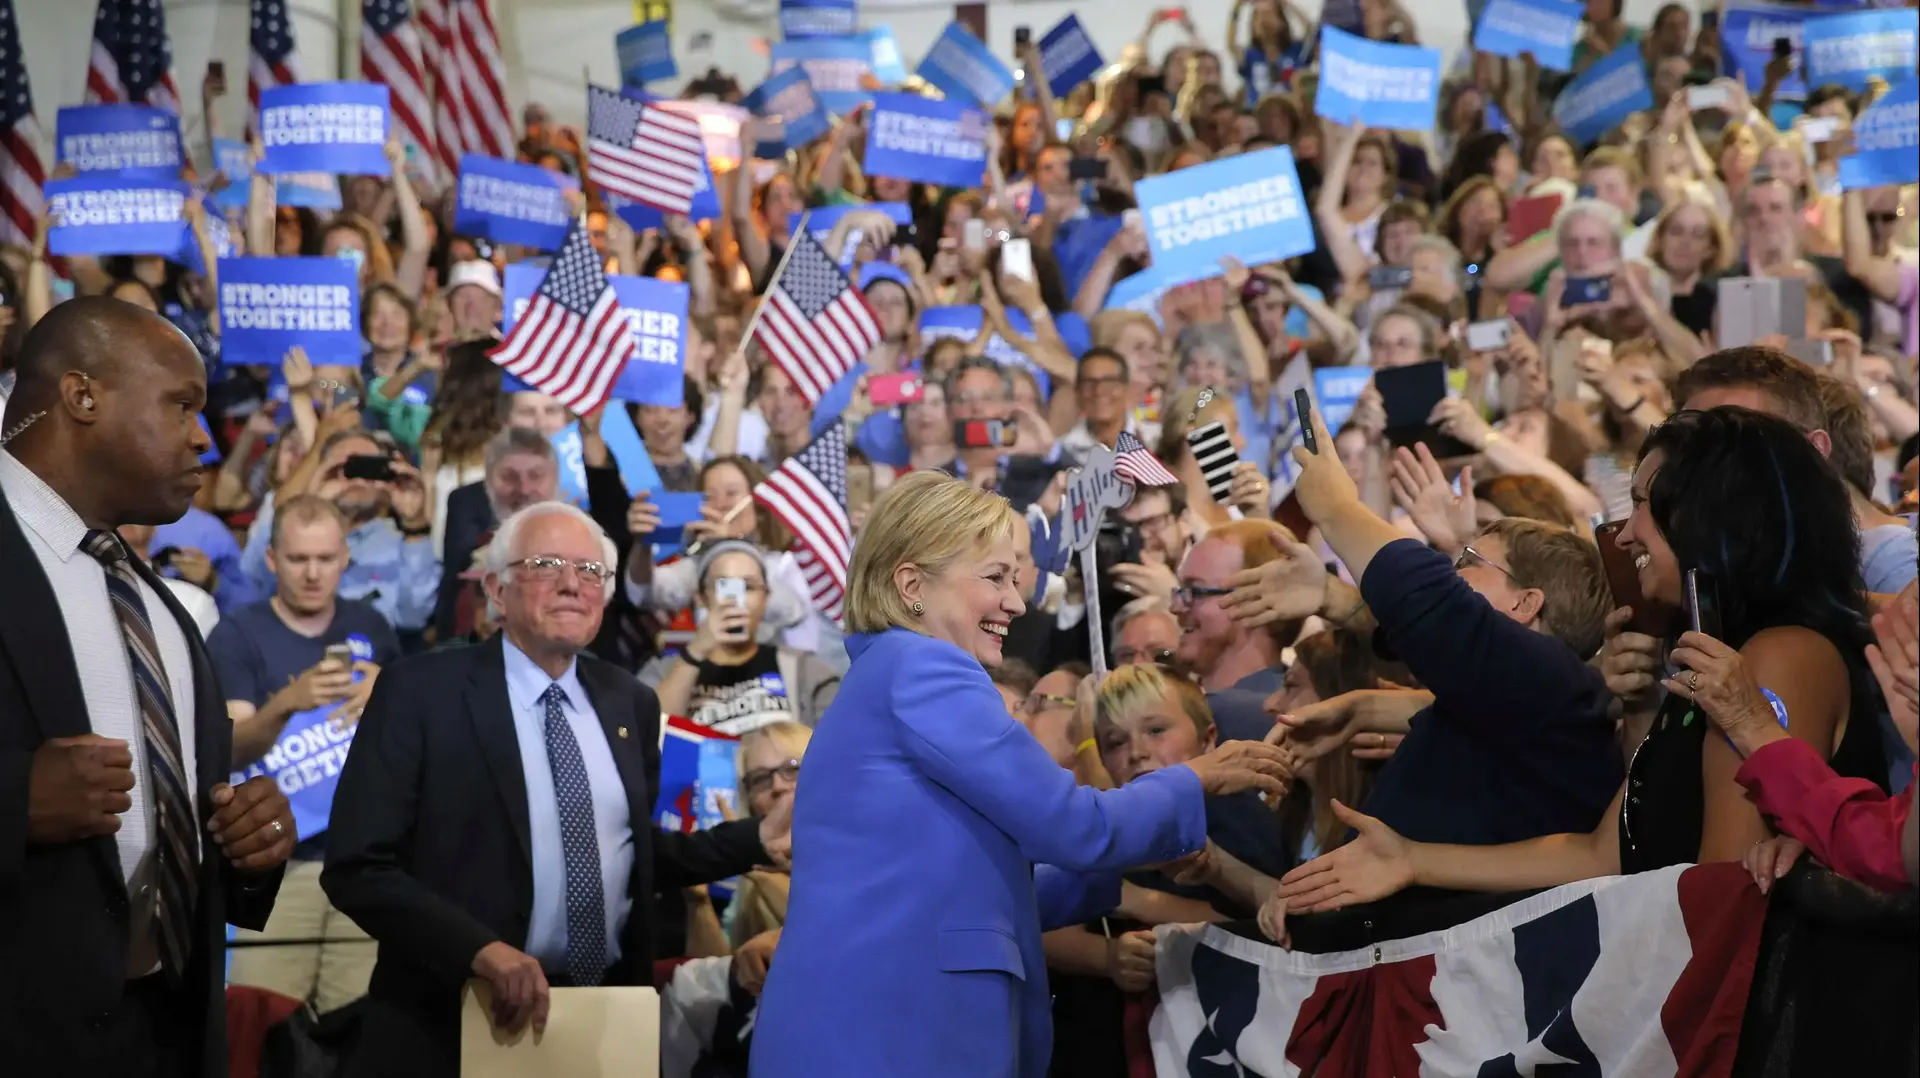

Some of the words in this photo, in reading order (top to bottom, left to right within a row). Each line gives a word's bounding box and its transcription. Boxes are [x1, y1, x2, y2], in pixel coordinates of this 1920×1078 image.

[263, 103, 384, 125] STRONGER
[64, 131, 177, 152] STRONGER
[264, 125, 385, 147] TOGETHER
[53, 189, 185, 211] STRONGER
[462, 172, 564, 206] STRONGE
[1150, 175, 1293, 228] STRONGER
[1154, 198, 1300, 250] TOGETHER
[222, 282, 352, 308] STRONGER
[222, 305, 352, 331] TOGETHER
